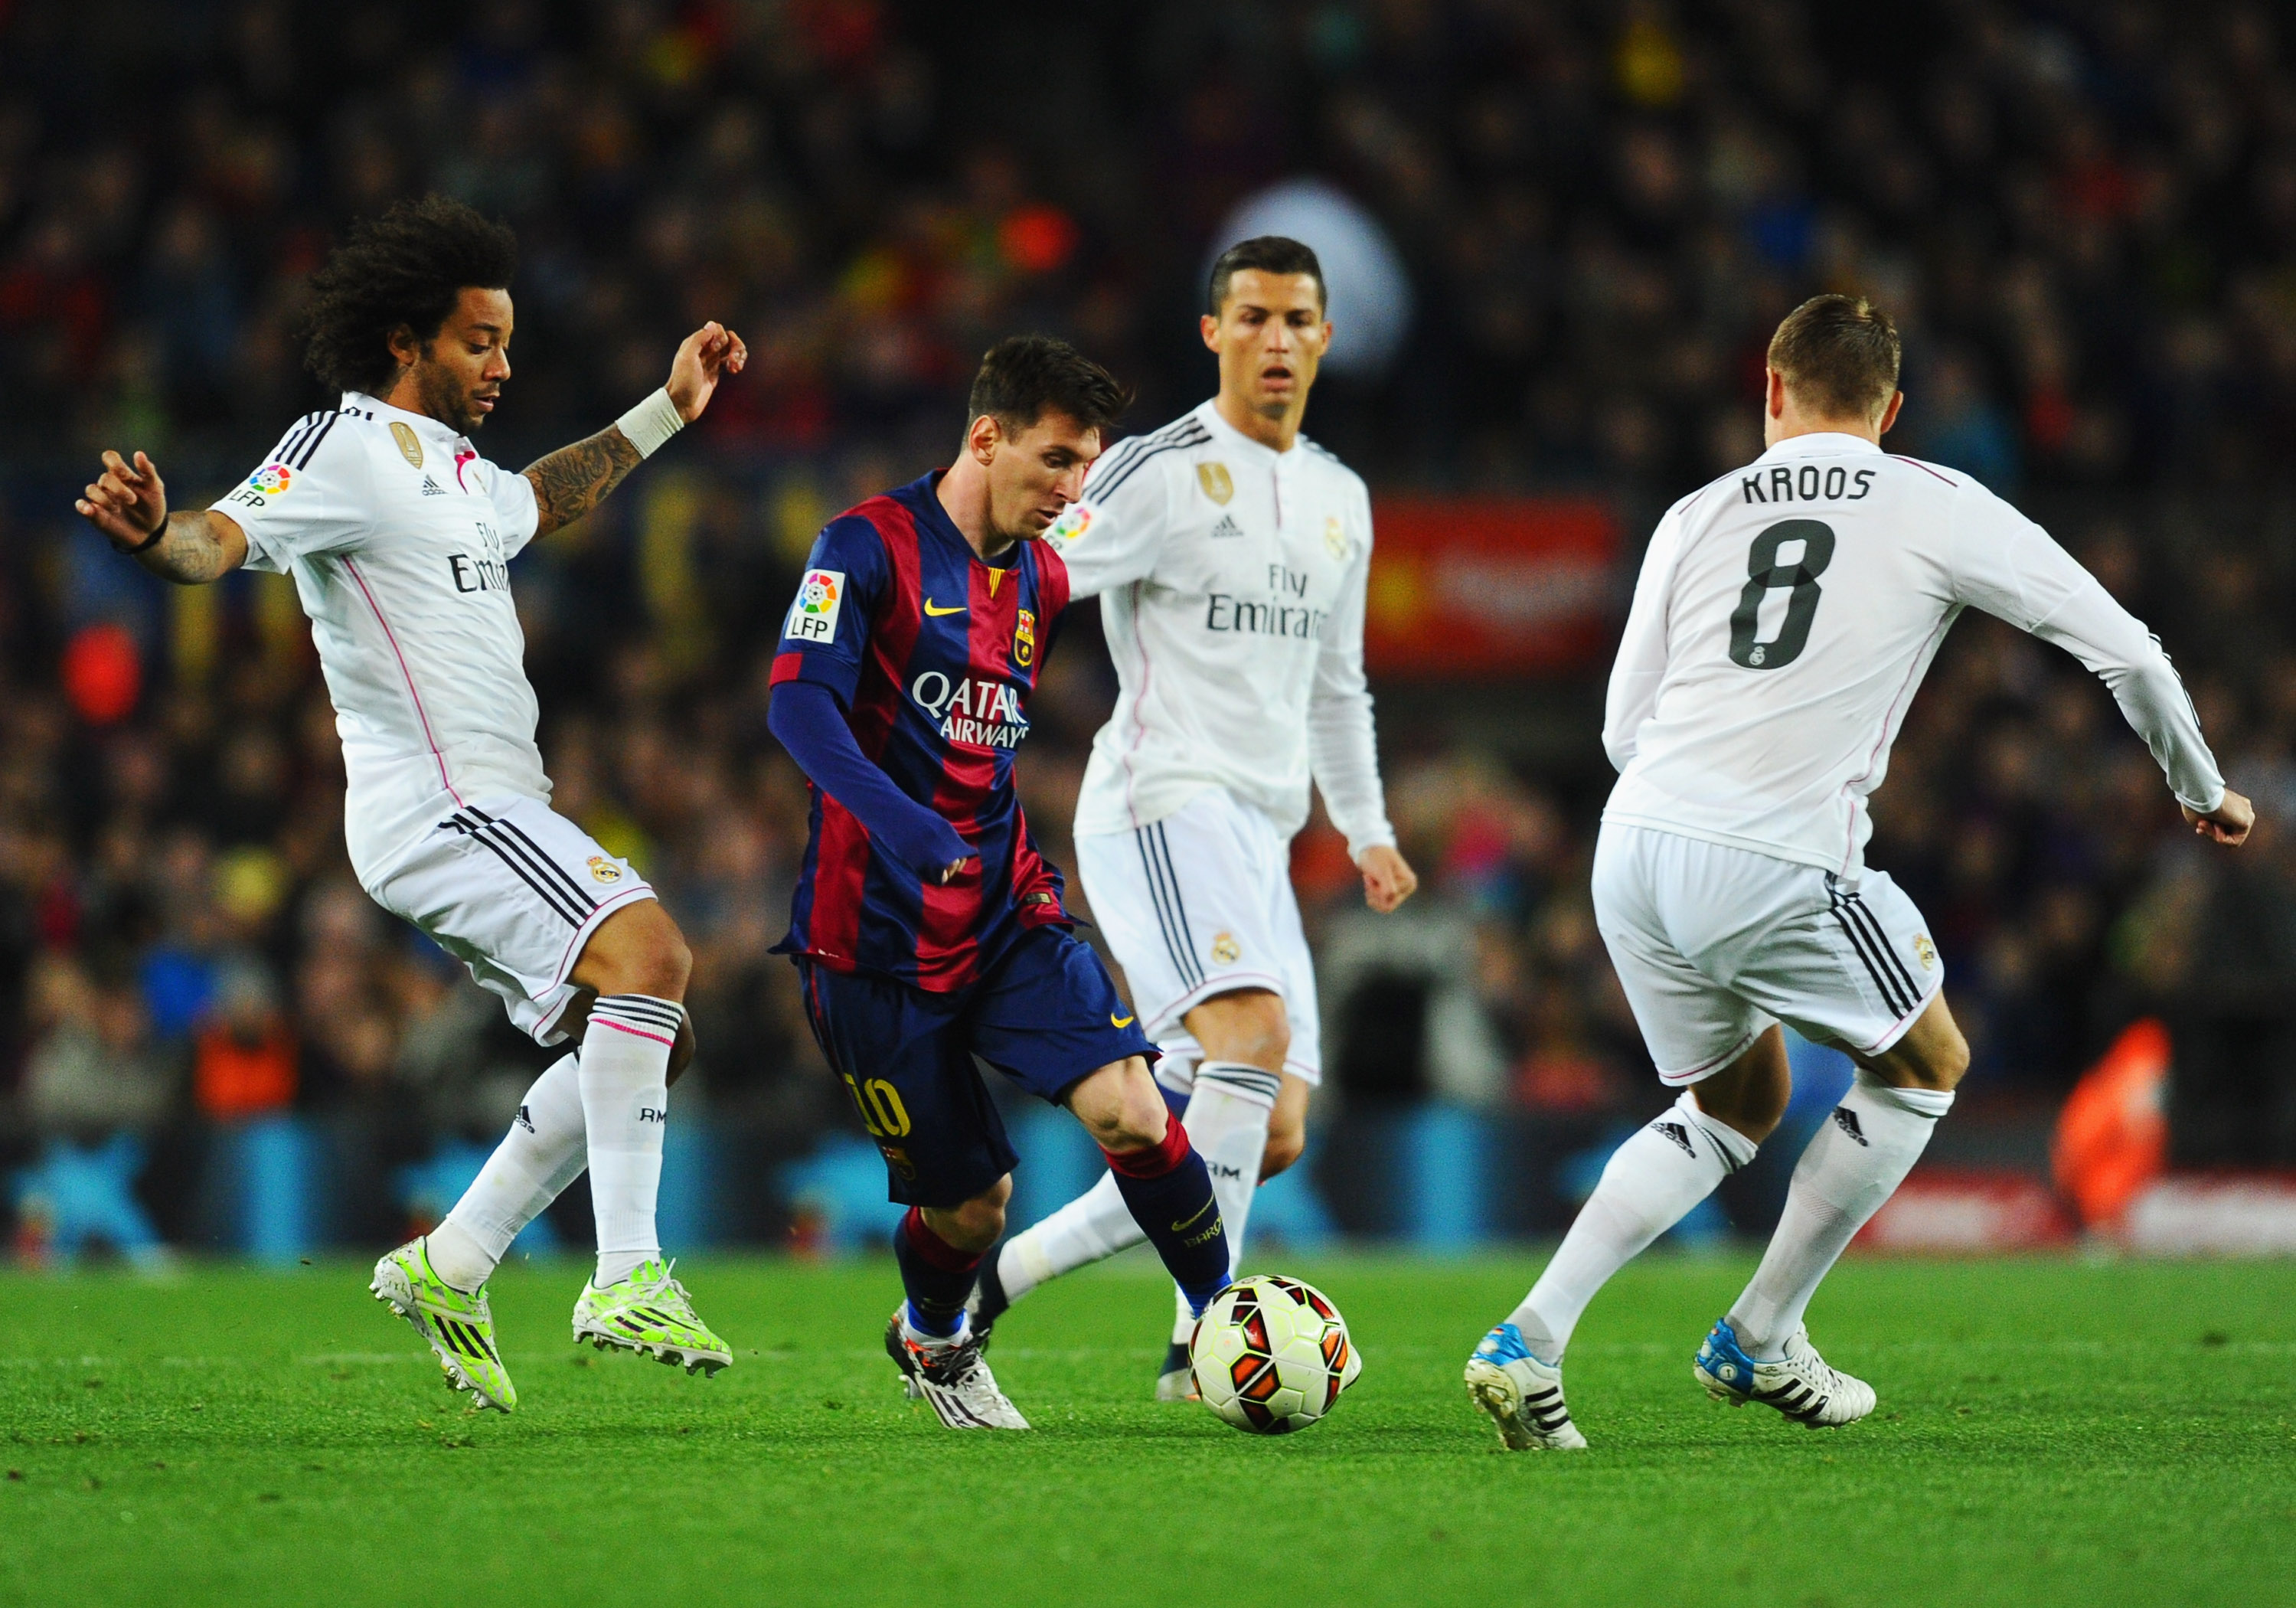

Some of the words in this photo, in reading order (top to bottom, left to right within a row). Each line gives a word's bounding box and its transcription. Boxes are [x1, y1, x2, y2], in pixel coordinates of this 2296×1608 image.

[229, 489, 265, 507] LFP
[1742, 466, 1876, 503] KROOS
[475, 522, 499, 553] Fly
[1269, 563, 1308, 598] Fly
[1729, 519, 1836, 669] 8
[792, 616, 828, 639] LFP
[912, 671, 1027, 724] QATAR
[639, 1107, 667, 1125] RM
[844, 1073, 911, 1137] 10
